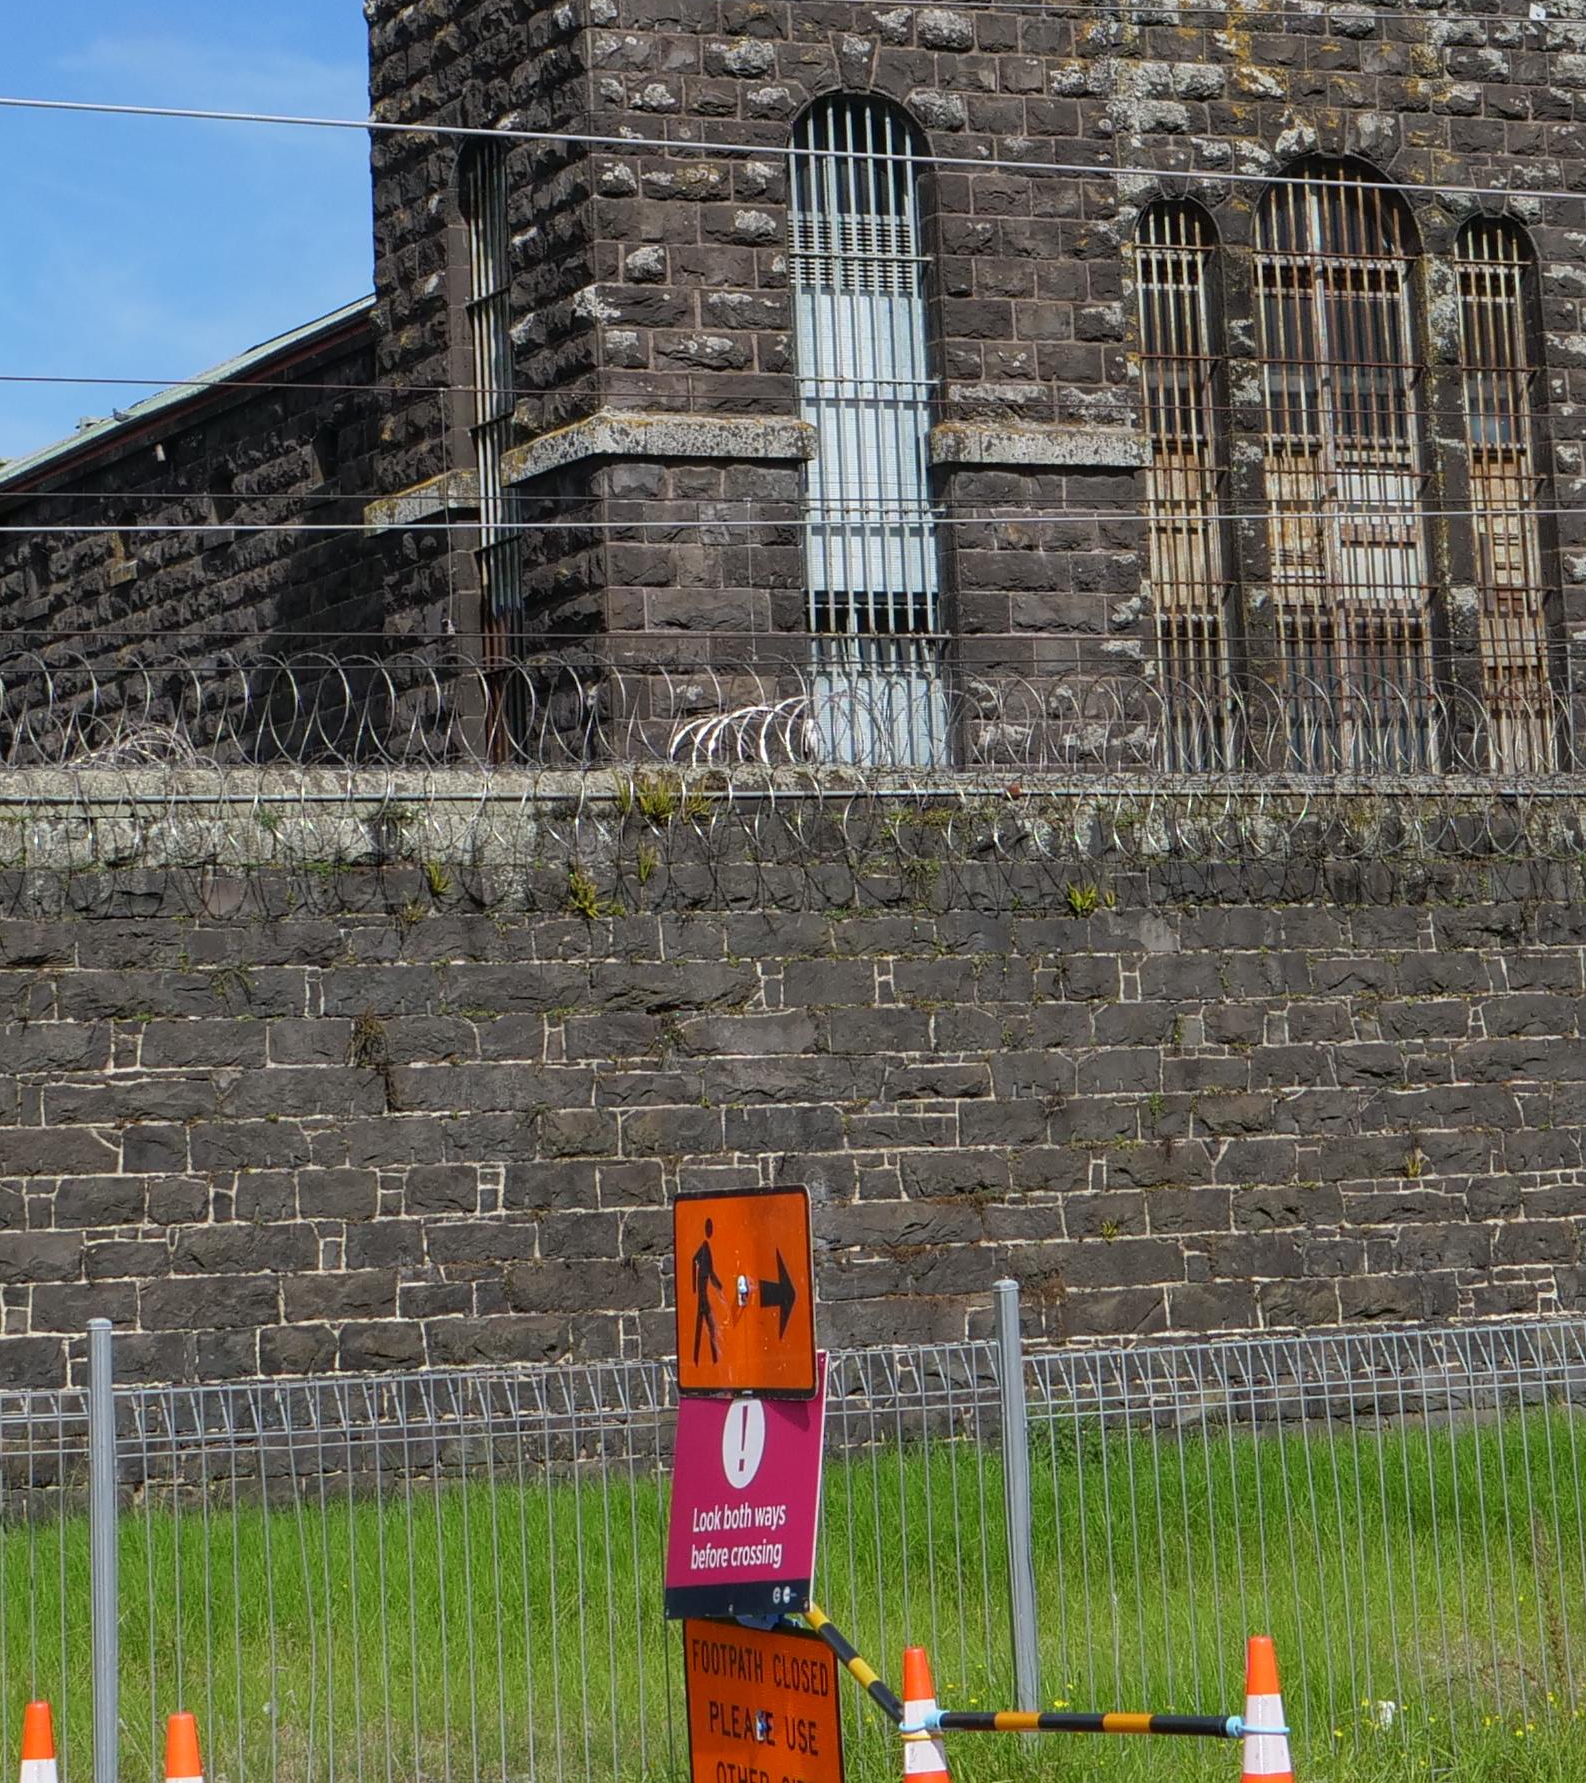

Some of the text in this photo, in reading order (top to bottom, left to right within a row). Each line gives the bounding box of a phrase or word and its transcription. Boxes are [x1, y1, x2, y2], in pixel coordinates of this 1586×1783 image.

[693, 1502, 786, 1532] Look both ways
[690, 1538, 783, 1570] before crossing
[692, 1639, 829, 1697] FOOTPATH CLOSED
[709, 1700, 818, 1756] PLEAE USE
